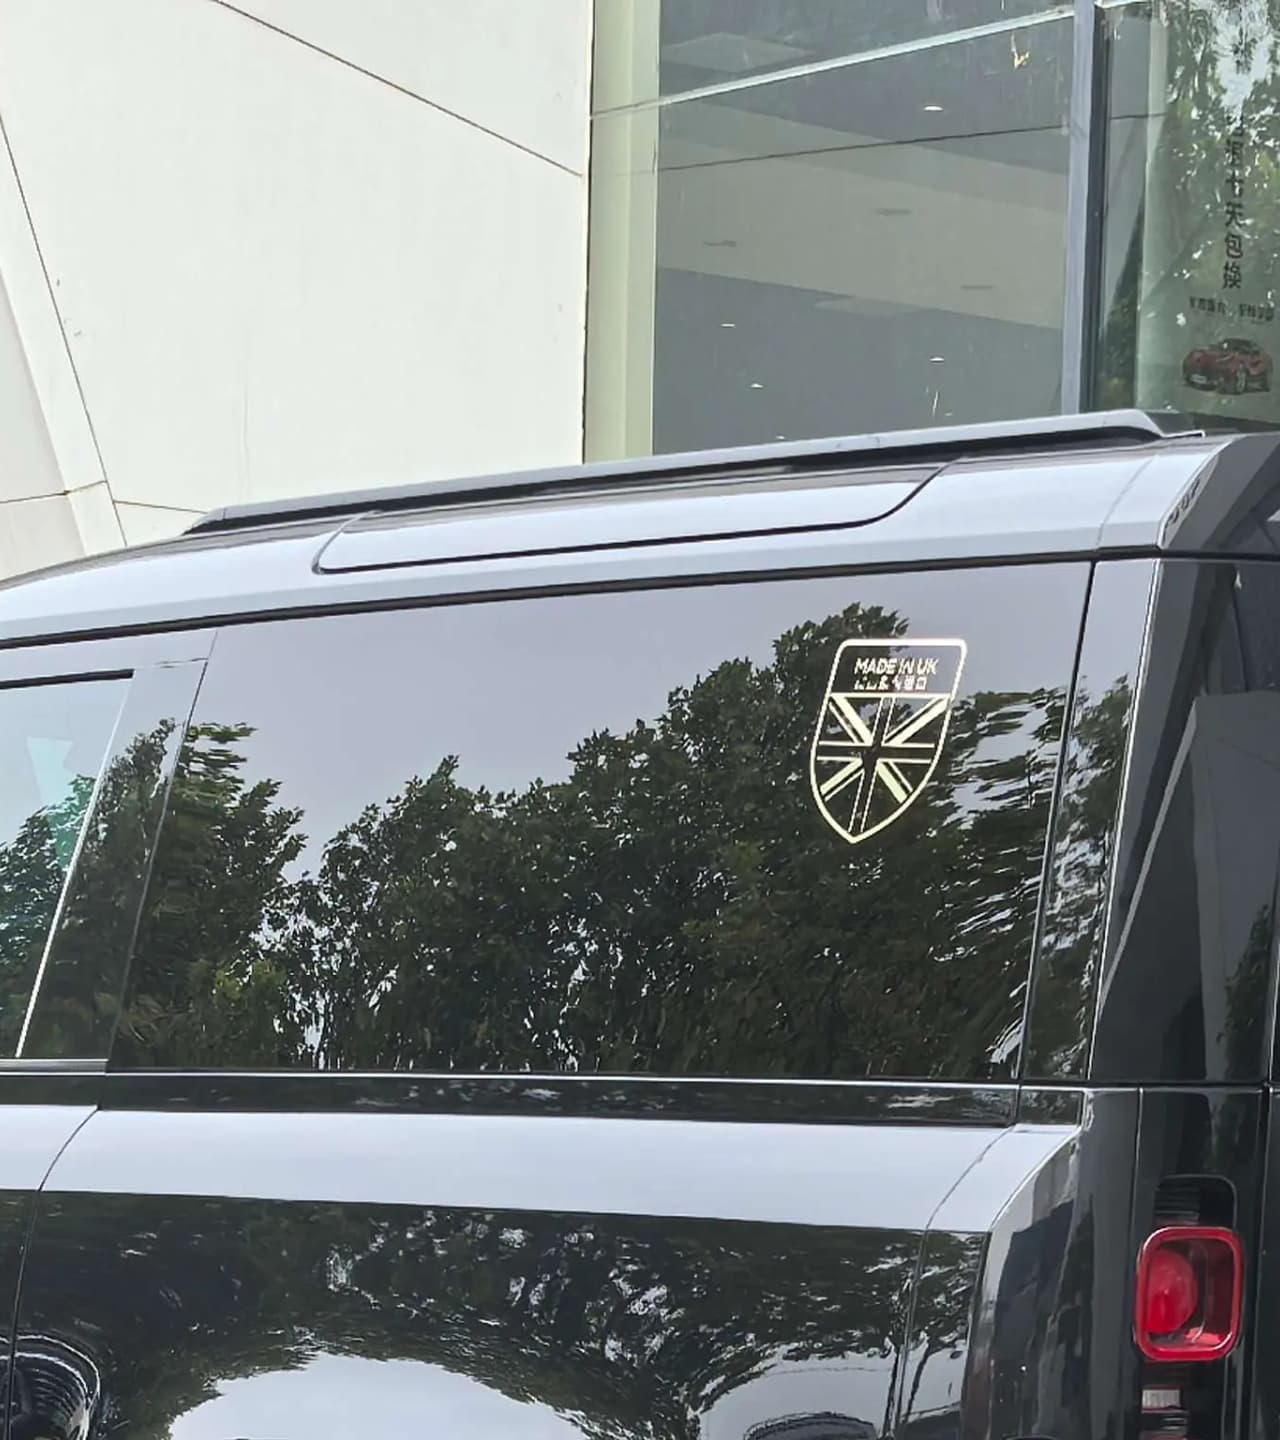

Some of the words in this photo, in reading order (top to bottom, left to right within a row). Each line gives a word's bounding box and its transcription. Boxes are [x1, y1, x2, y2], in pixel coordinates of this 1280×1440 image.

[854, 657, 897, 675] MADE
[898, 657, 915, 675] IN
[917, 657, 939, 675] UK
